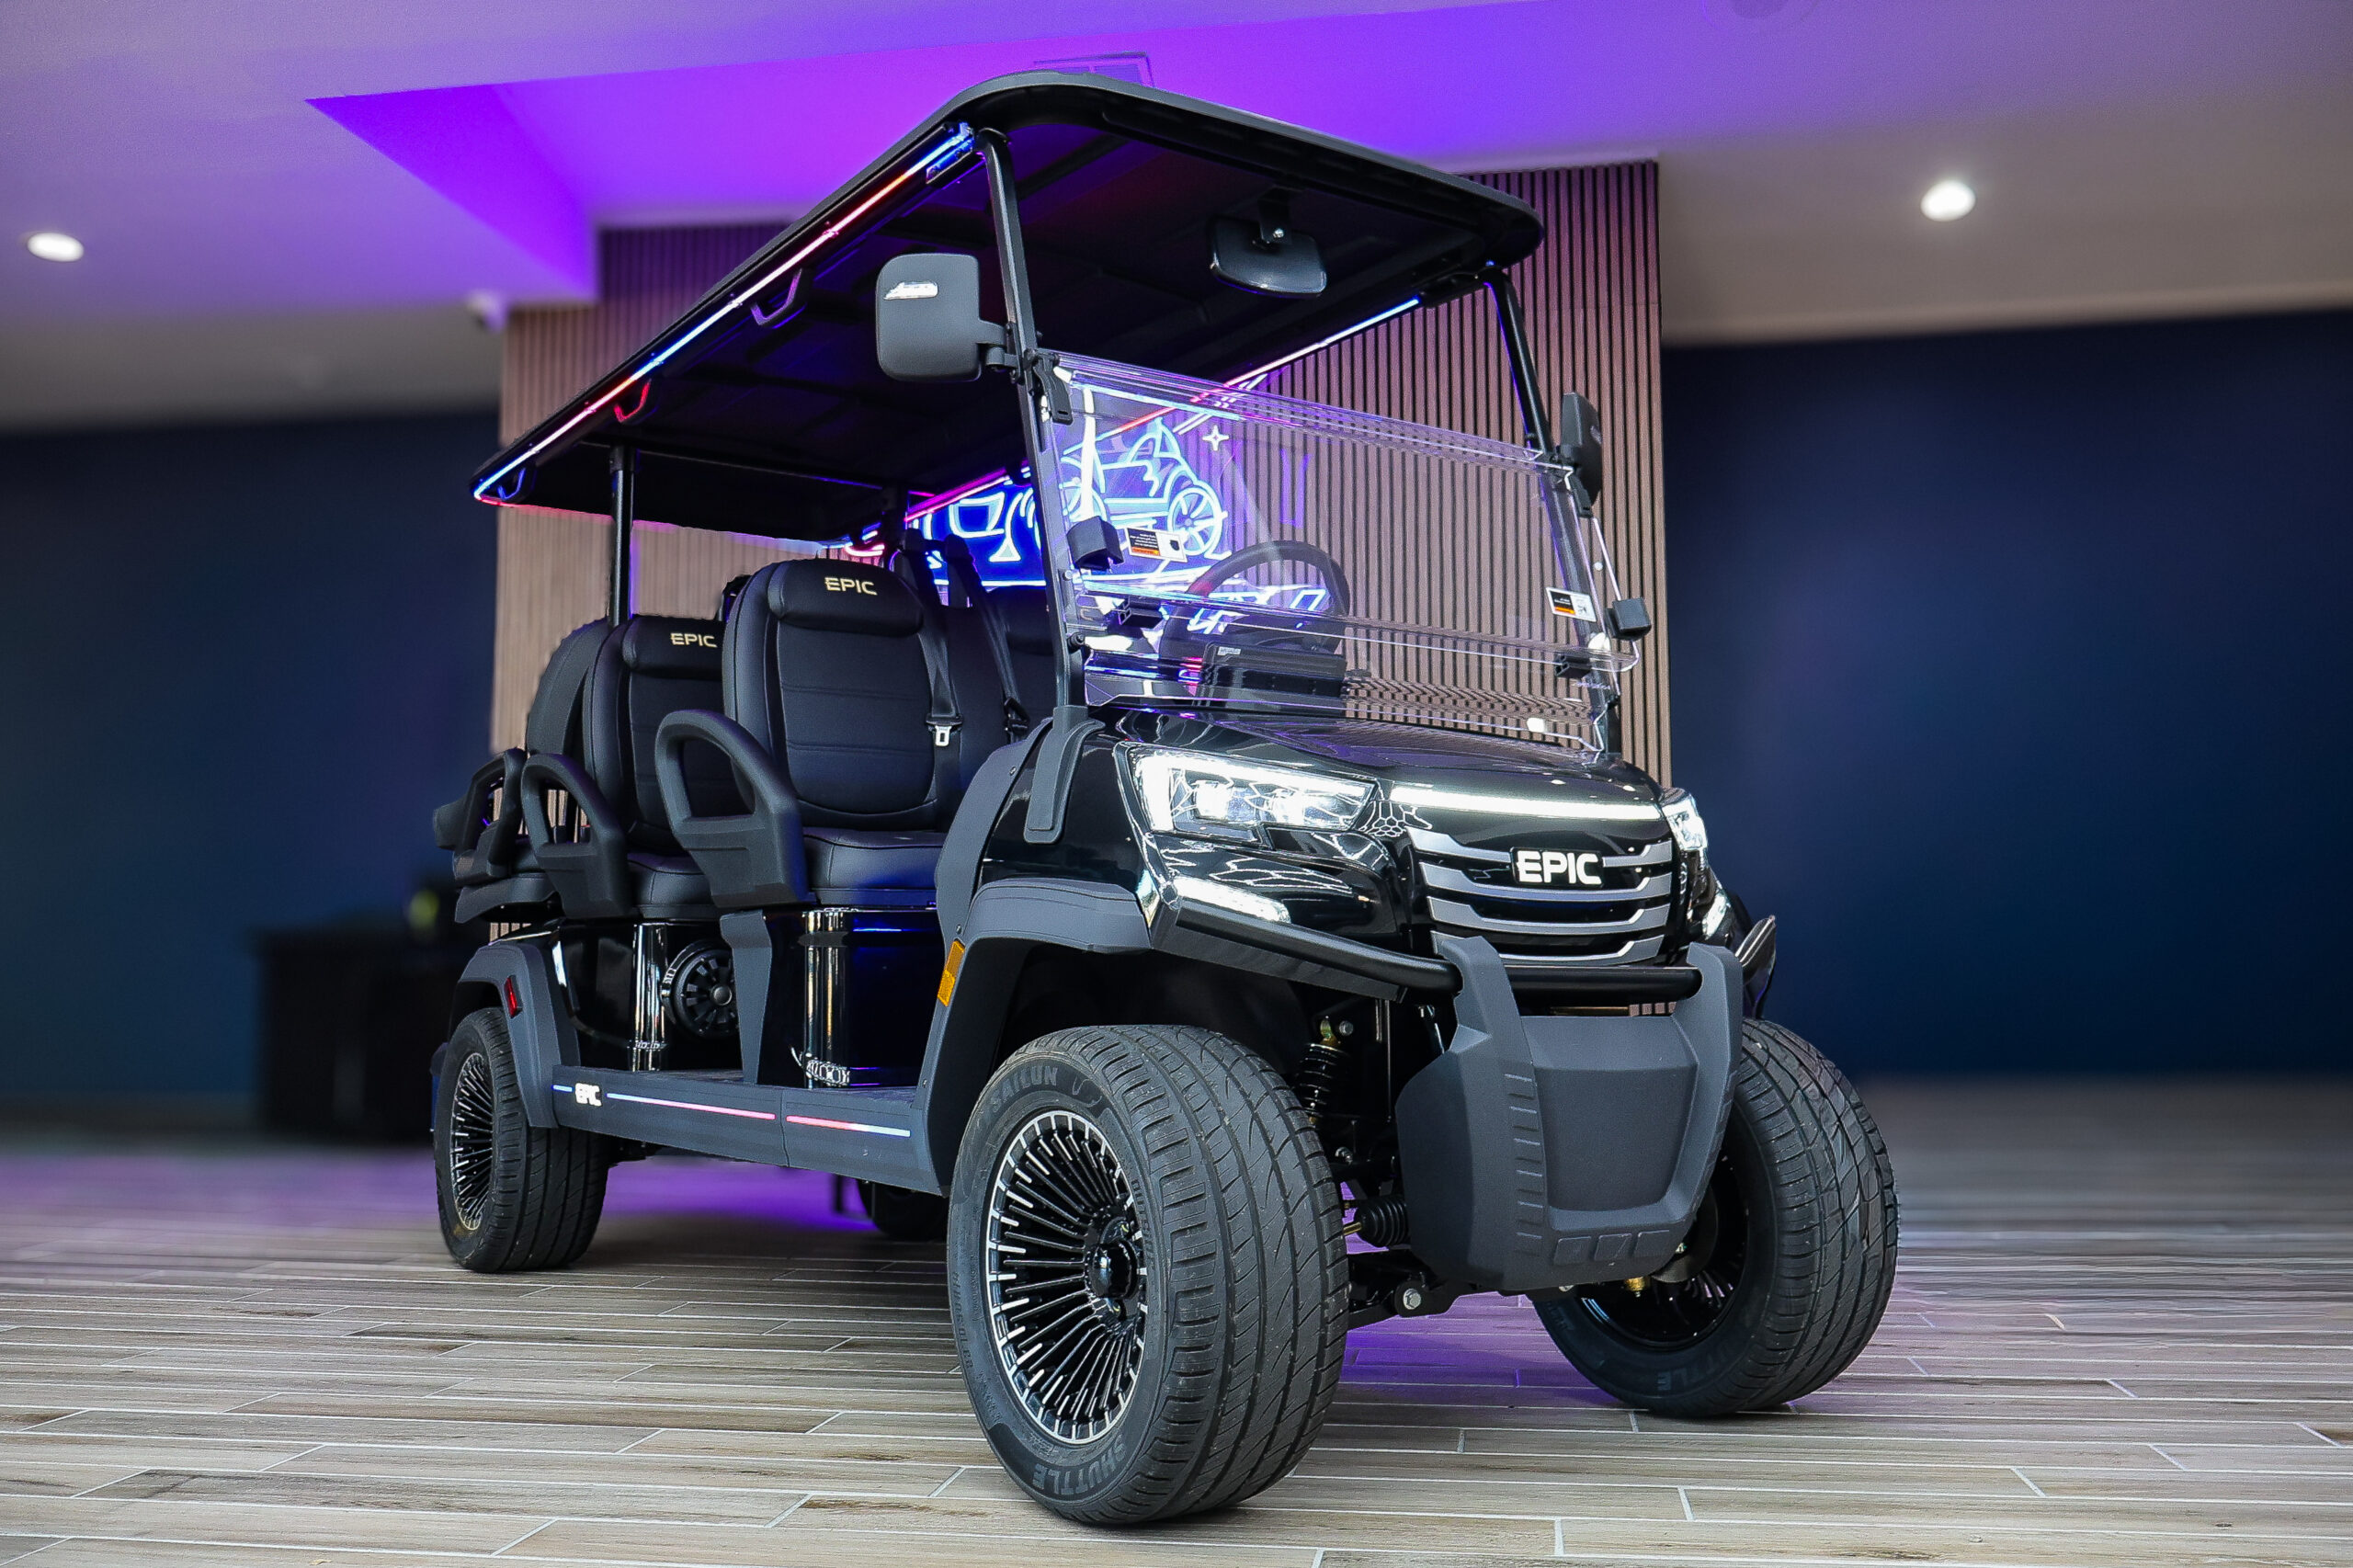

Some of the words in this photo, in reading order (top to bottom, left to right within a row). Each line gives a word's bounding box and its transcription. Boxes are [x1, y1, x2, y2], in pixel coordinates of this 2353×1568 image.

[824, 576, 878, 596] EPIC
[670, 632, 718, 648] EPIC
[1517, 850, 1602, 884] EPIC
[991, 1065, 1058, 1113] SAILUN
[1032, 1434, 1126, 1495] SHUTTLE
